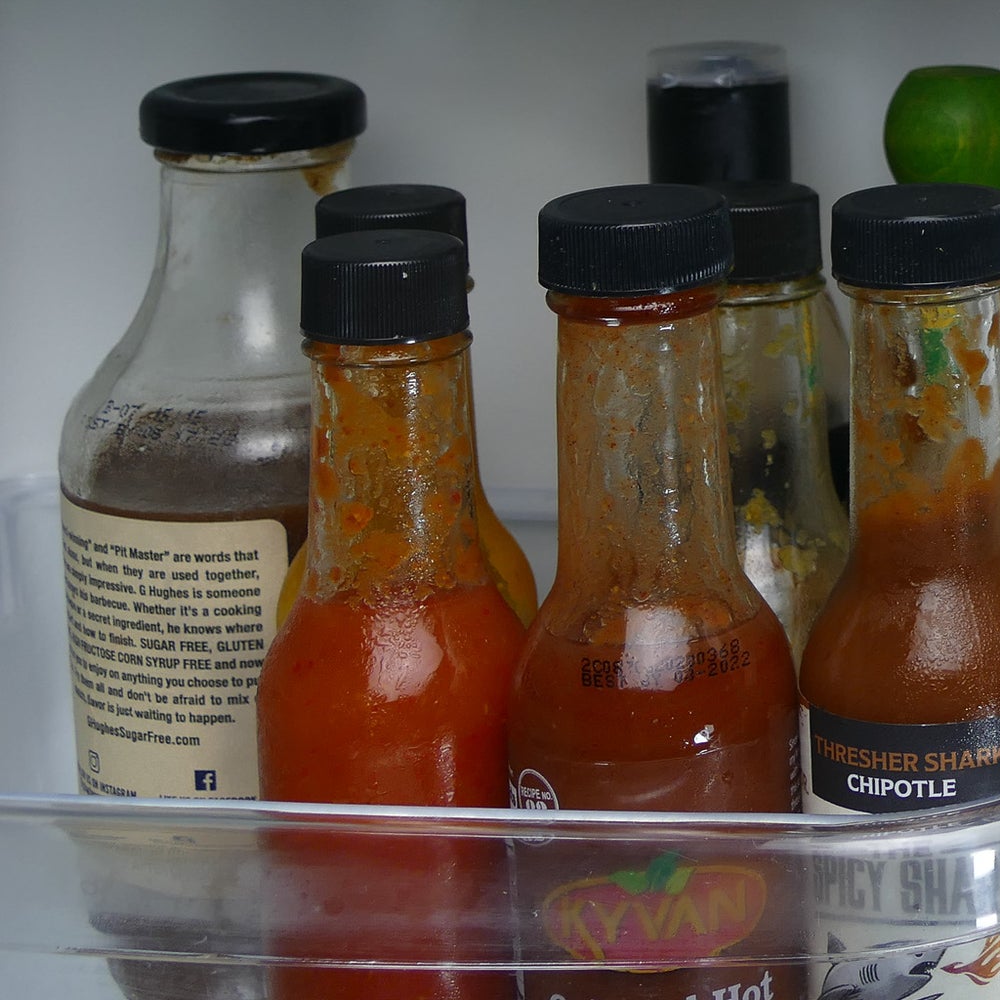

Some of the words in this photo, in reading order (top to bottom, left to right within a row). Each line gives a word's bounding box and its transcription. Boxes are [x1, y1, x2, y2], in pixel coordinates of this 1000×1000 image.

[93, 542, 108, 555] and
[173, 553, 191, 563] are
[194, 551, 231, 563] words
[234, 549, 259, 561] that
[95, 560, 119, 574] when
[123, 563, 143, 580] they
[148, 569, 166, 580] are
[171, 569, 199, 581] used
[205, 568, 260, 583] together,
[88, 574, 136, 594] impressive.
[139, 584, 146, 597] G
[149, 586, 189, 600] Hughes
[192, 587, 203, 599] is
[206, 587, 261, 599] someone
[90, 591, 130, 612] barbecue.
[133, 601, 176, 616] Whether
[180, 605, 199, 617] it's
[202, 607, 210, 617] a
[213, 604, 263, 617] cooking
[87, 610, 110, 626] secret
[112, 615, 164, 635] ingredient,
[167, 622, 181, 634] he
[183, 622, 222, 635] knows
[225, 622, 263, 634] where
[80, 639, 116, 662] FRUCTOSE
[118, 651, 143, 666] CORN
[145, 655, 180, 670] SYRUP
[183, 658, 212, 671] FREE
[215, 658, 237, 671] and
[240, 658, 264, 670] now
[98, 630, 107, 642] to
[109, 632, 136, 648] finish.
[140, 637, 176, 652] SUGAR
[180, 641, 213, 654] FREE,
[217, 638, 264, 653] GLUTEN
[88, 661, 108, 679] enjoy
[109, 669, 120, 680] on
[121, 672, 163, 688] anything
[166, 678, 184, 689] you
[187, 677, 229, 689] choose
[232, 676, 243, 688] to
[96, 681, 106, 694] all
[108, 686, 124, 698] and
[127, 689, 151, 703] don't
[155, 692, 169, 704] be
[172, 693, 206, 706] afraid
[210, 694, 223, 706] to
[227, 694, 250, 706] mix
[107, 701, 115, 714] is
[116, 703, 134, 717] just
[135, 708, 172, 725] waiting
[175, 710, 186, 723] to
[189, 710, 236, 726] happen.
[814, 734, 919, 773] THRESHER
[520, 786, 541, 799] RECIPE
[541, 790, 554, 801] NO.
[847, 773, 957, 799] CHIPOTLE
[813, 853, 885, 912] SPICY
[557, 879, 748, 959] KYVAN
[712, 970, 774, 1000] Hot
